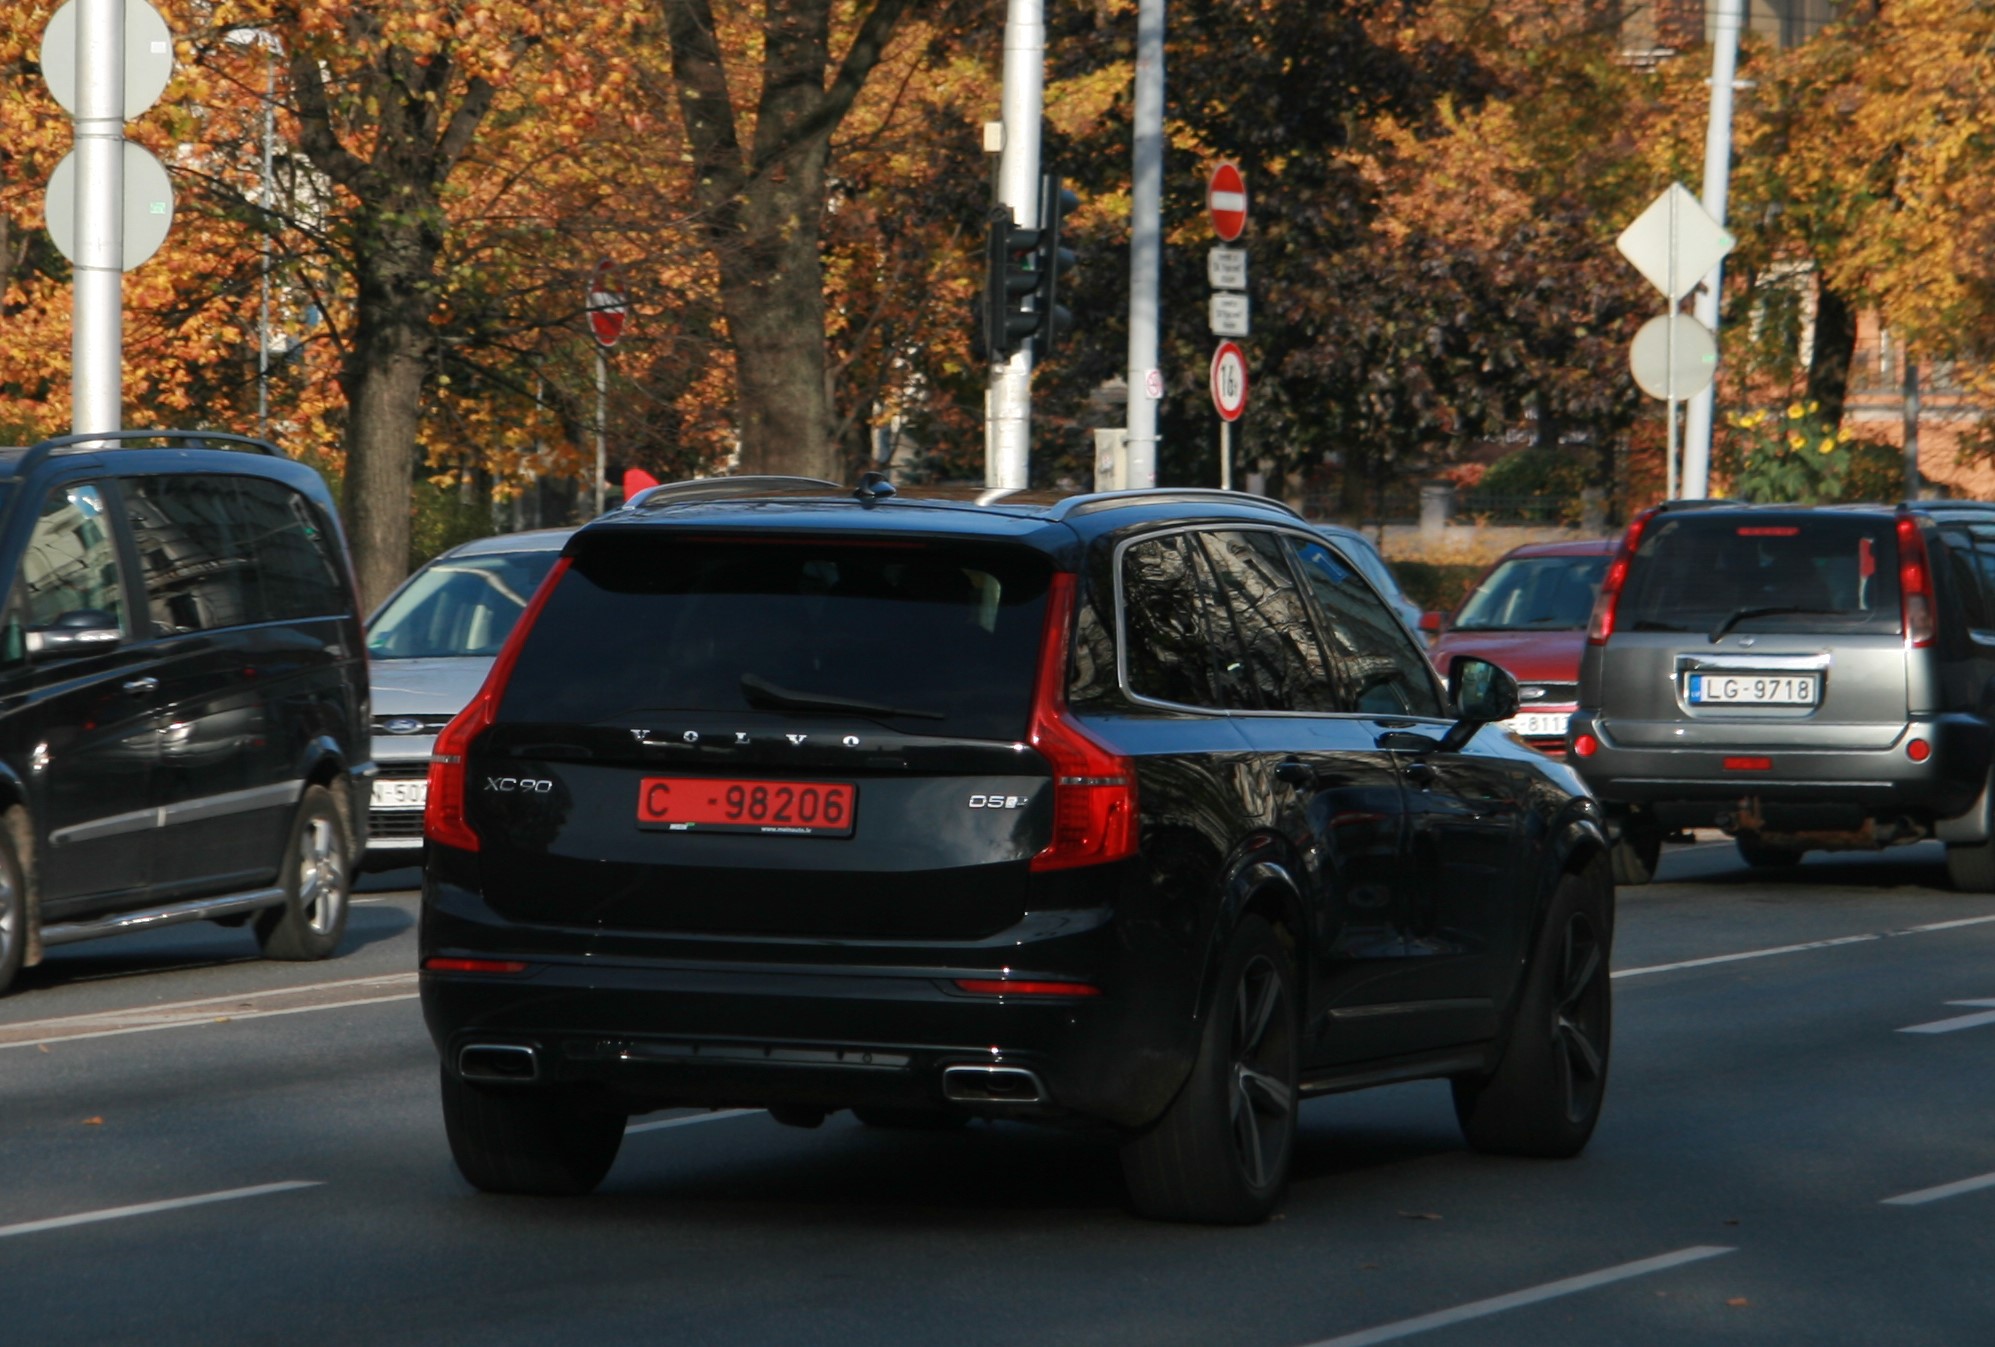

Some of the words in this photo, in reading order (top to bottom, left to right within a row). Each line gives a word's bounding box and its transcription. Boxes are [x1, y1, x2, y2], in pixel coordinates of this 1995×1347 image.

[1706, 679, 1809, 700] LG-9718
[630, 729, 860, 748] VOLVO
[646, 783, 670, 817] C
